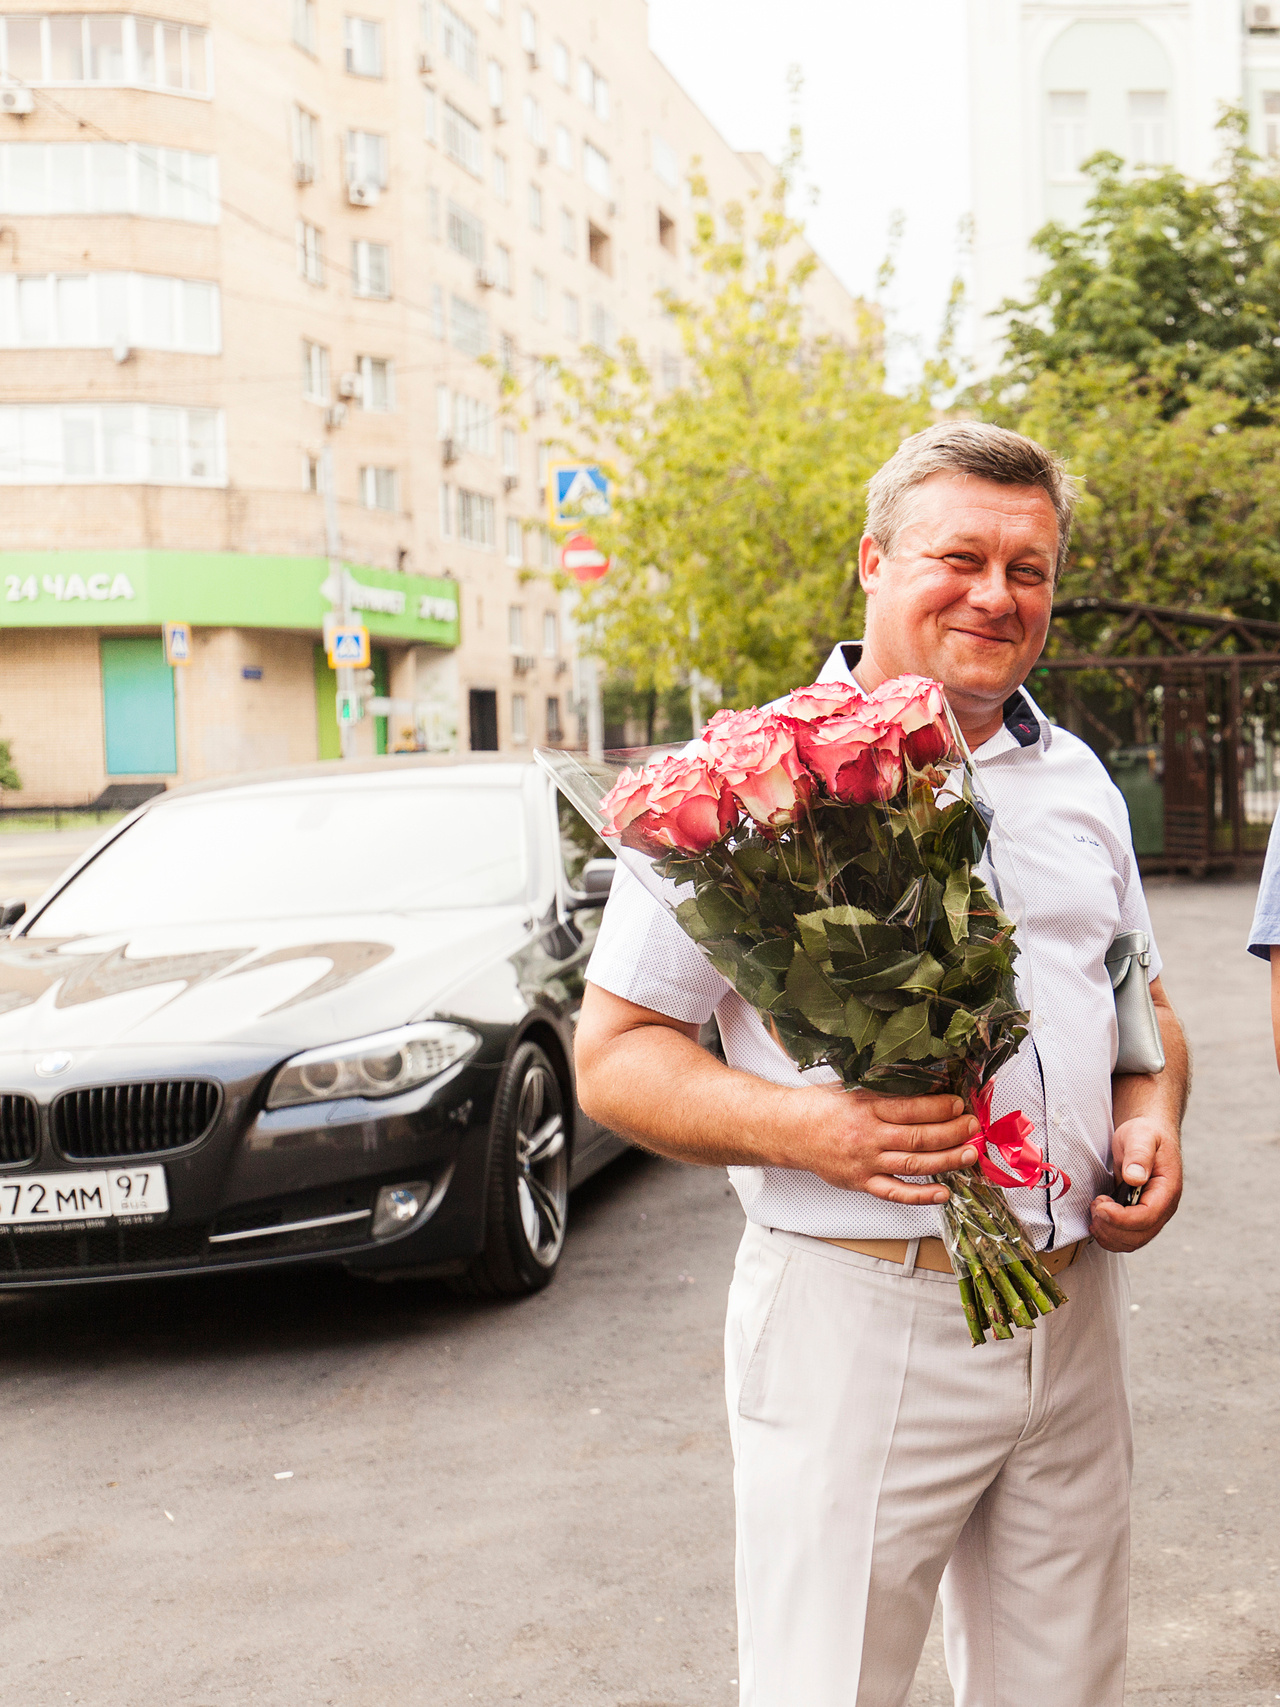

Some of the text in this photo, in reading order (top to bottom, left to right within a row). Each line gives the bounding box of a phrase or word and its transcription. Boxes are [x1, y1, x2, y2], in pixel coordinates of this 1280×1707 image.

[5, 572, 136, 601] 24 ЧАСА
[0, 1173, 149, 1215] 72MM 97
